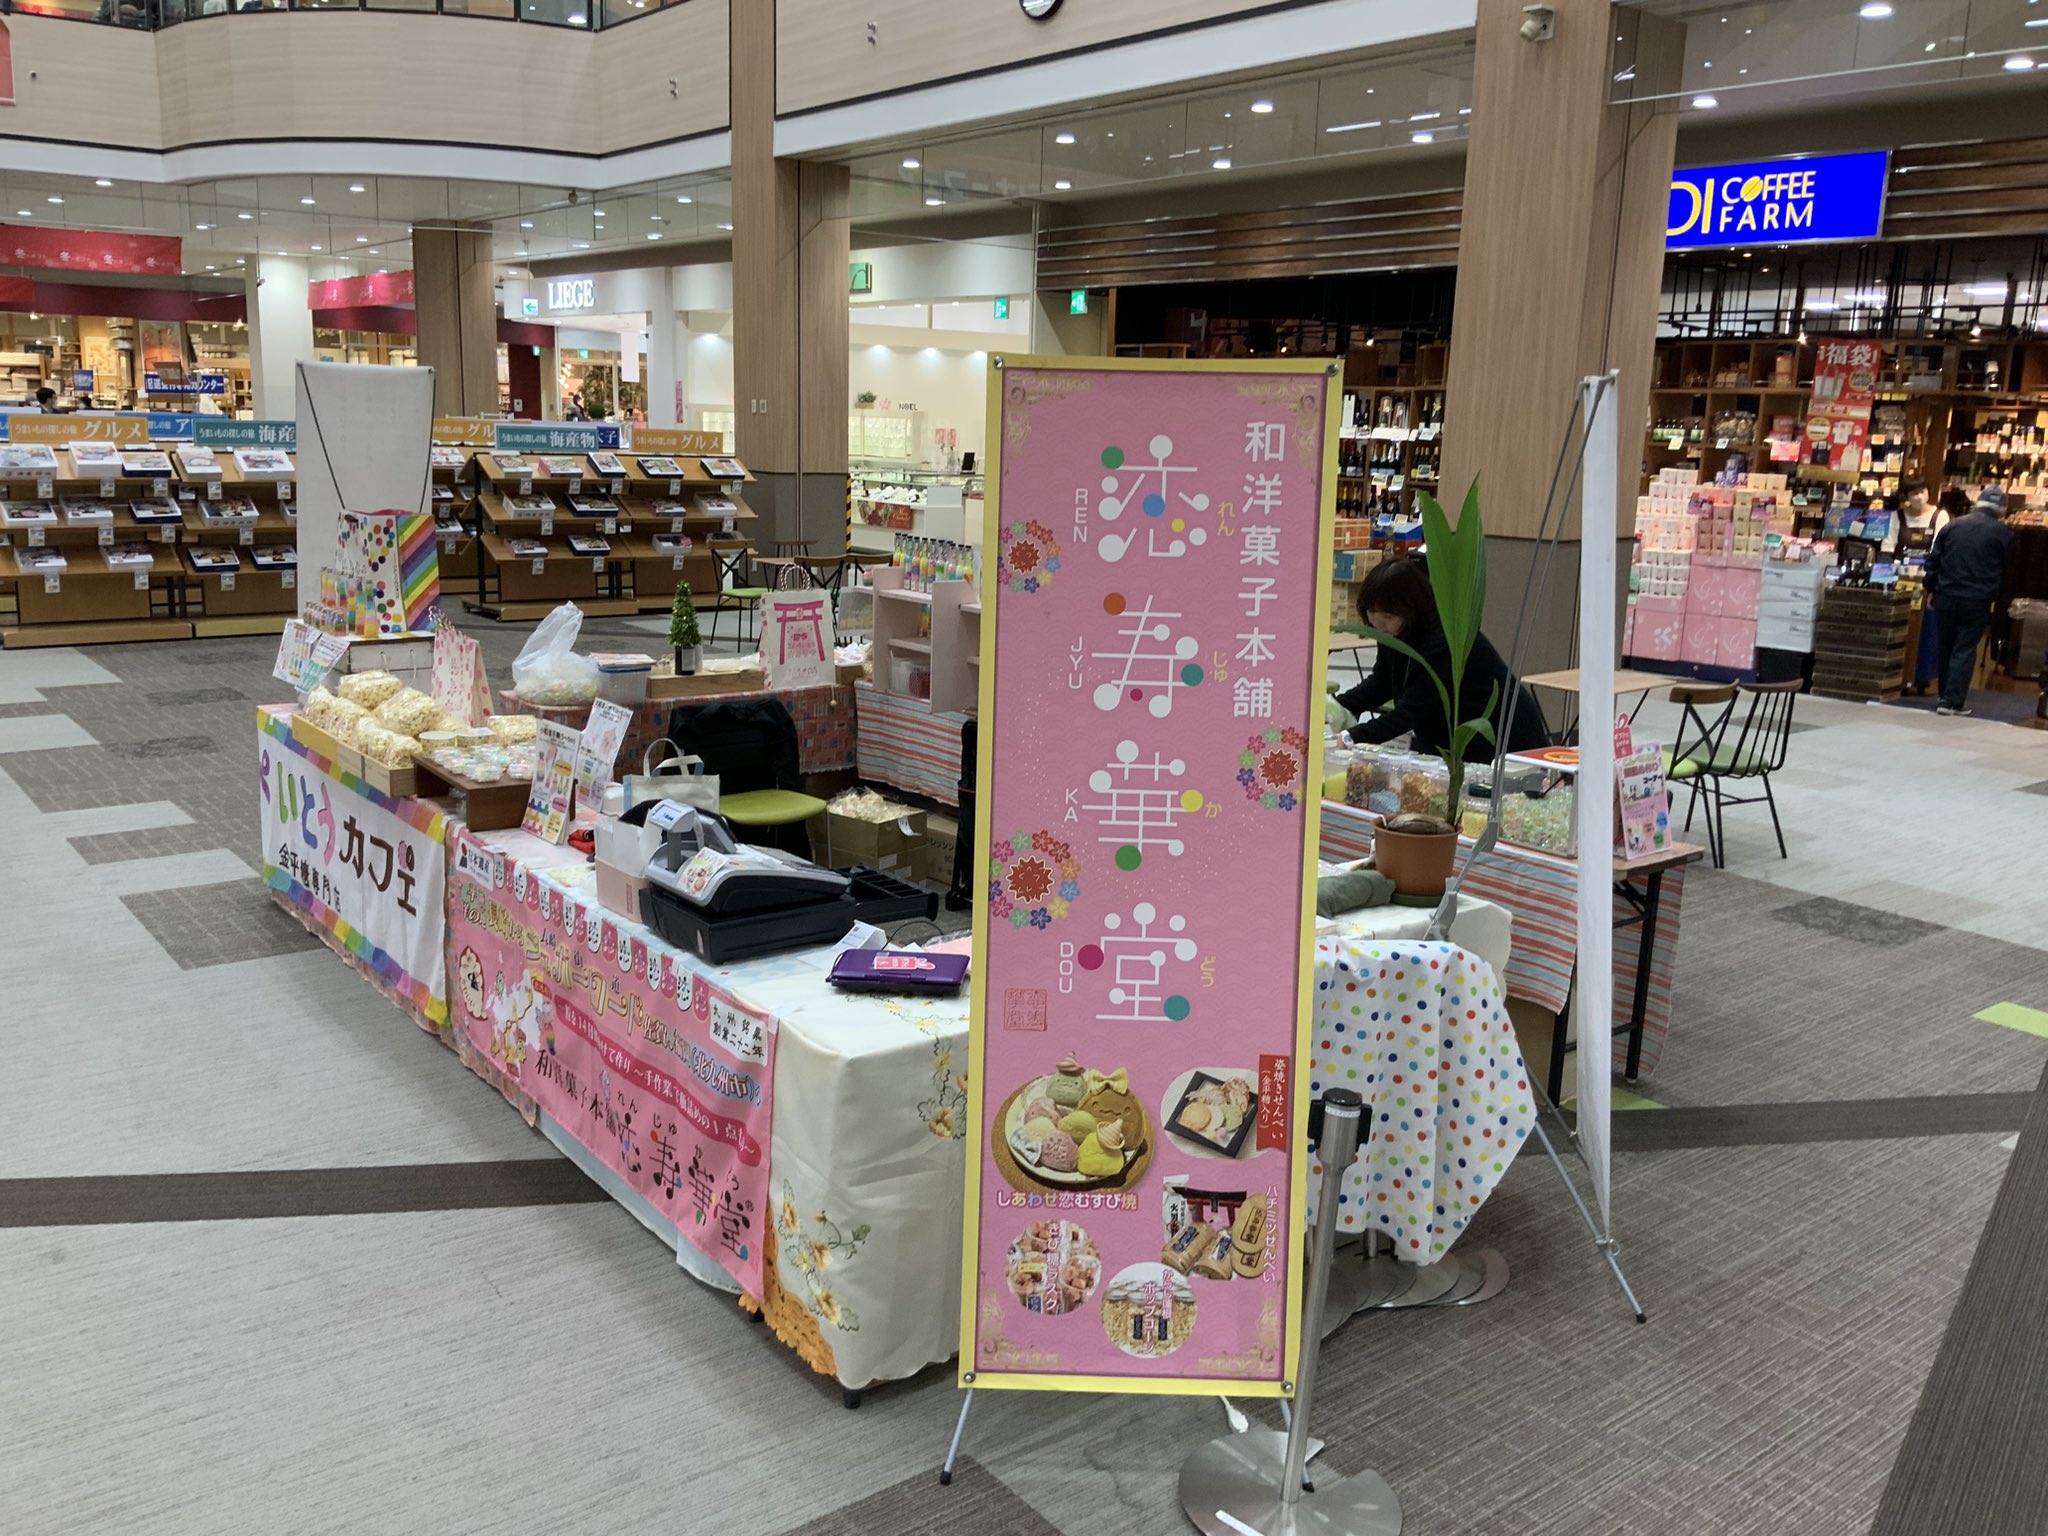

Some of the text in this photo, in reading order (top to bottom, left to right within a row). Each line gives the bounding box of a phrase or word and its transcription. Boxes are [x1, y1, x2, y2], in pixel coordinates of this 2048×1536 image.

[1721, 170, 1817, 205] COFFEE
[1719, 201, 1814, 233] FARM
[548, 279, 595, 310] LIEGE
[1826, 343, 1873, 367] 福袋
[898, 402, 918, 411] NOEL
[82, 419, 142, 439] グルメ
[549, 430, 596, 449] 海産物
[680, 432, 720, 450] グルメ
[1073, 488, 1088, 543] REN
[1217, 501, 1236, 537] れん
[1232, 421, 1286, 718] 和洋菓子本舗
[1068, 635, 1084, 690] JYU
[1213, 651, 1228, 682] じゅ
[1064, 788, 1079, 822] KA
[1205, 801, 1223, 818] か
[1059, 942, 1075, 994] DOU
[1200, 955, 1217, 988] どう
[1271, 1058, 1287, 1140] 姿焼きせんべい
[996, 1190, 1139, 1212] しあわせ恋むすび焼
[1262, 1184, 1279, 1283] ハチミツせんべい
